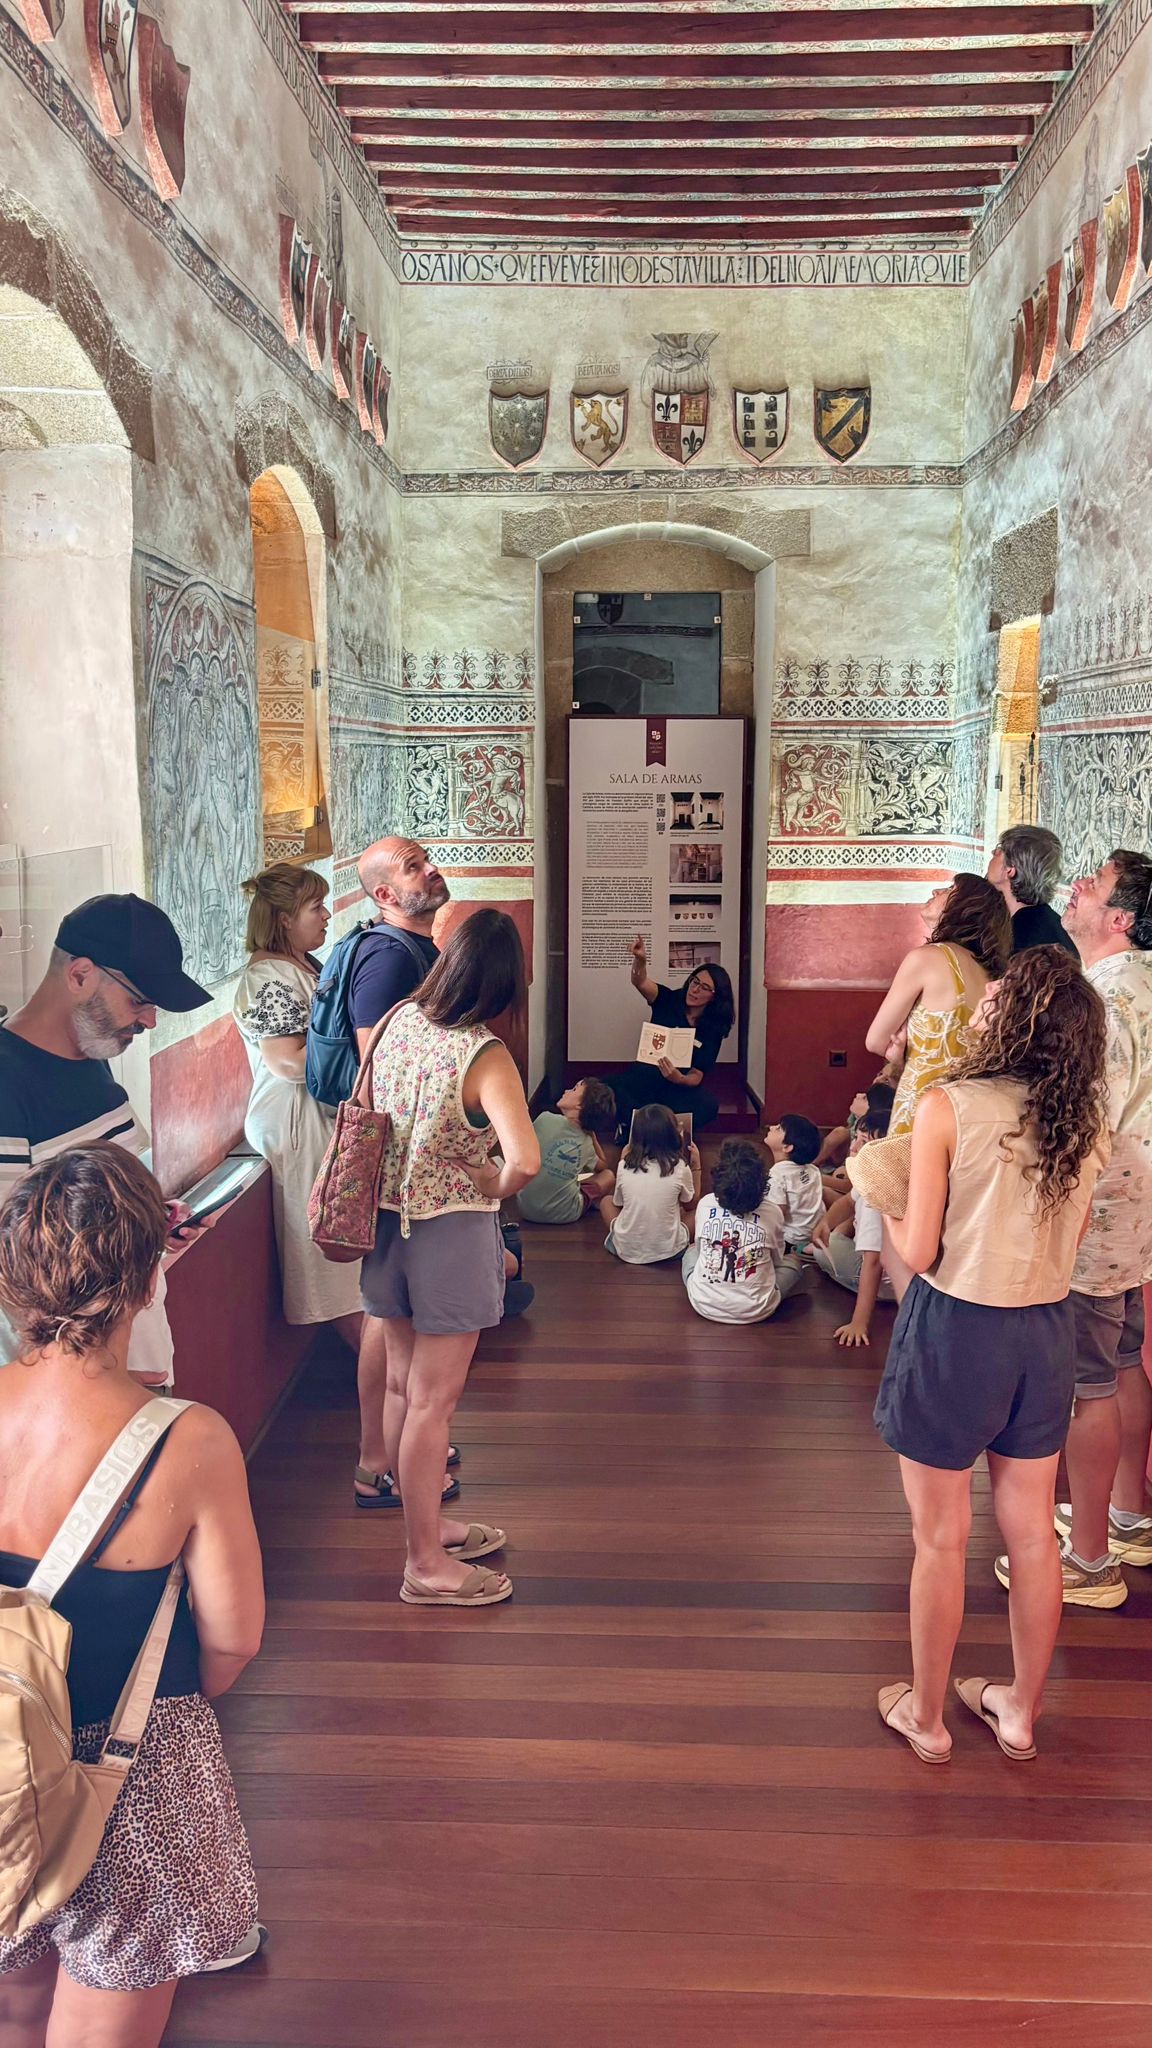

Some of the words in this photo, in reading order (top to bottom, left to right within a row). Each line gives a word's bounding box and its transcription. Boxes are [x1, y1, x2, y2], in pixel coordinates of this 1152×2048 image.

[609, 773, 639, 785] SALA
[642, 773, 658, 785] DE
[661, 773, 703, 785] ARMAS
